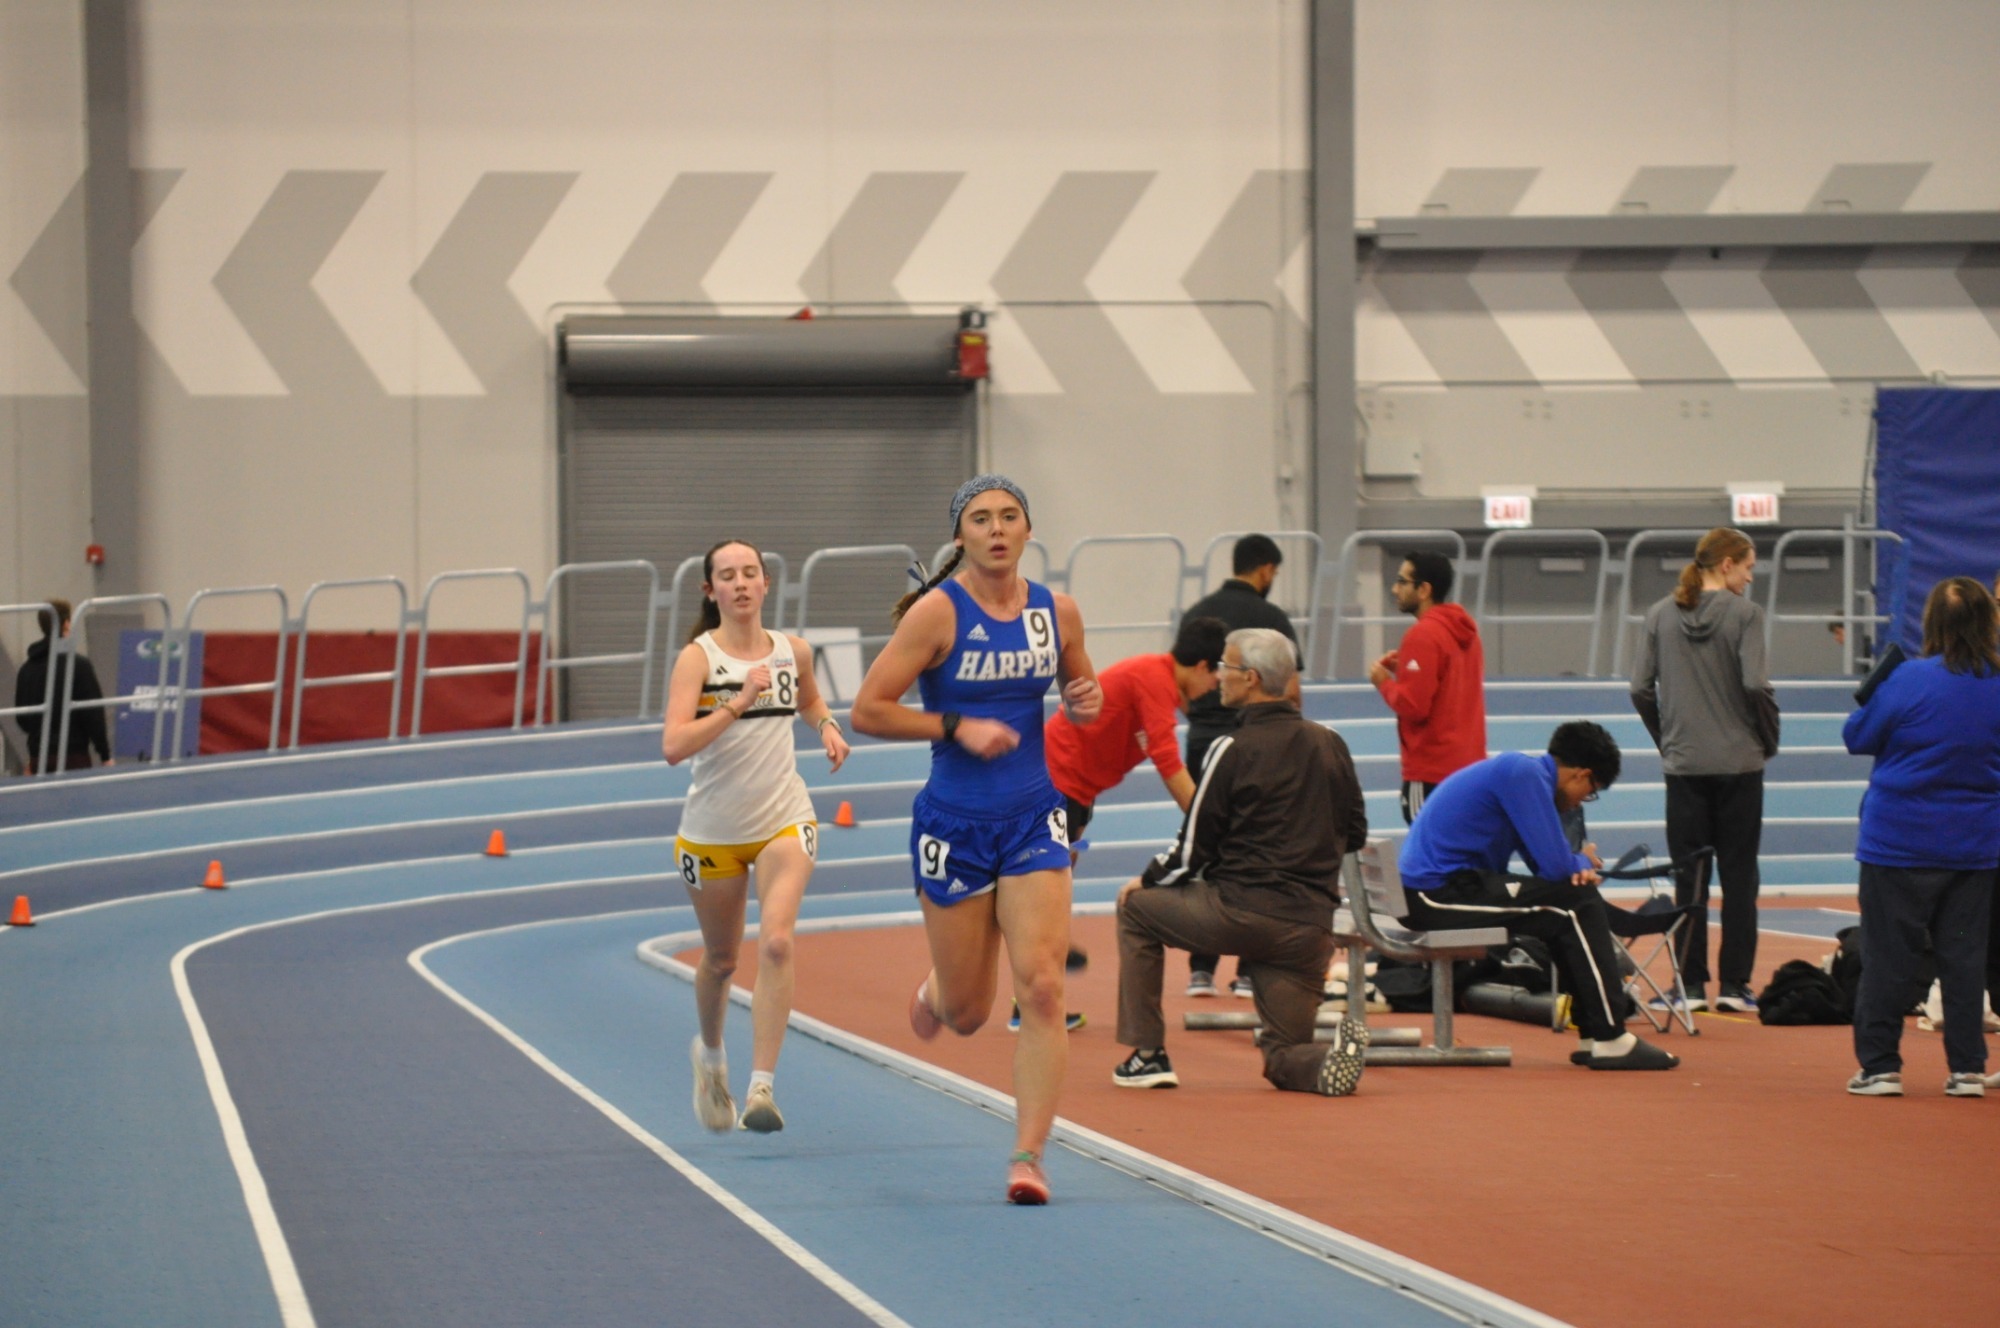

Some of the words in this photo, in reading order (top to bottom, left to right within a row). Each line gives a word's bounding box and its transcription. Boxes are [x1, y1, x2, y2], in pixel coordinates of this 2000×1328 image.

[1029, 611, 1050, 649] 9
[955, 648, 1058, 681] HARPER
[777, 670, 792, 705] 8
[803, 825, 815, 857] 8
[1052, 809, 1067, 841] 9
[682, 853, 696, 885] 8
[924, 839, 942, 876] 9
